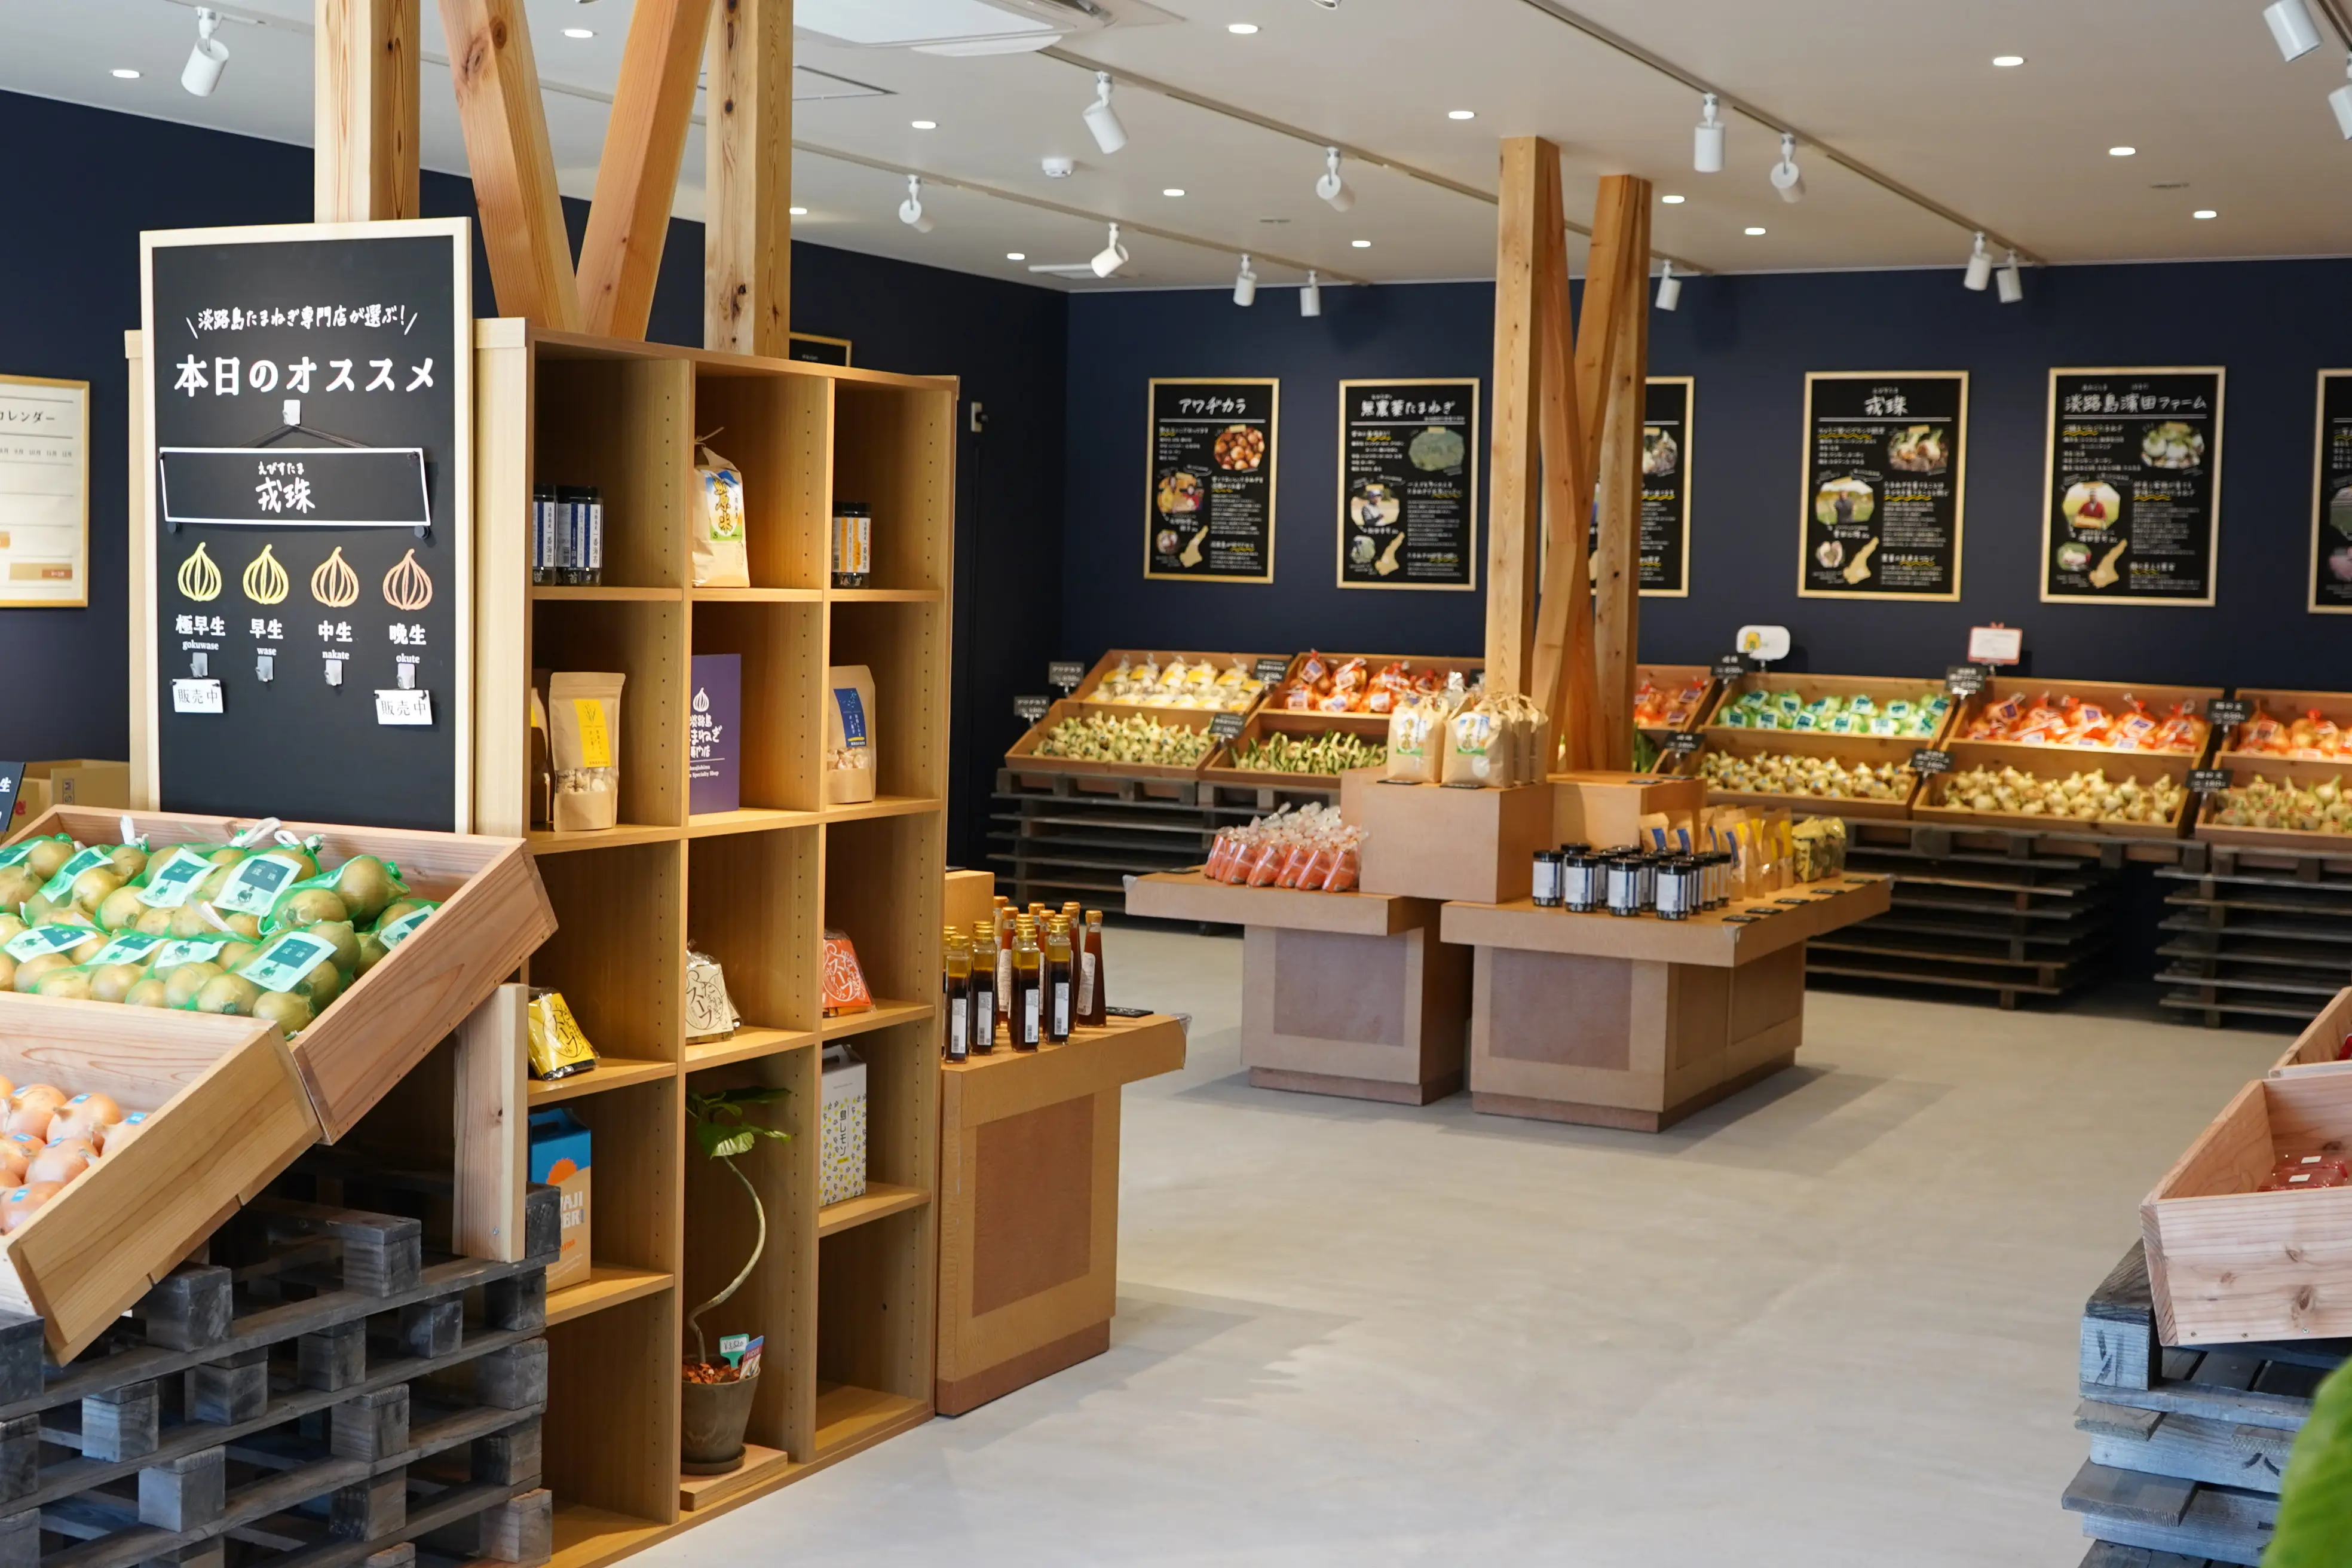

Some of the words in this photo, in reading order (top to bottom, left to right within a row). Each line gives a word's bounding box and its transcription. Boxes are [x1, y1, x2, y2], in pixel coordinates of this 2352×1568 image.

[174, 354, 434, 397] 本日のオススメ
[1178, 396, 1247, 415] アワヂカラ
[258, 460, 305, 476] えびすたま
[255, 477, 316, 514] 戎珠
[176, 614, 226, 636] 極早生
[249, 619, 284, 640] 早生
[318, 620, 353, 642] 中生
[388, 623, 427, 645] 晩生
[182, 640, 219, 651] gokuwase
[257, 648, 277, 656] wase
[322, 650, 350, 660] nakate
[396, 654, 420, 664] okute
[178, 688, 218, 705] 販売中
[381, 700, 427, 716] 販売中
[690, 725, 722, 745] まねぎ
[561, 1190, 583, 1212] AJI
